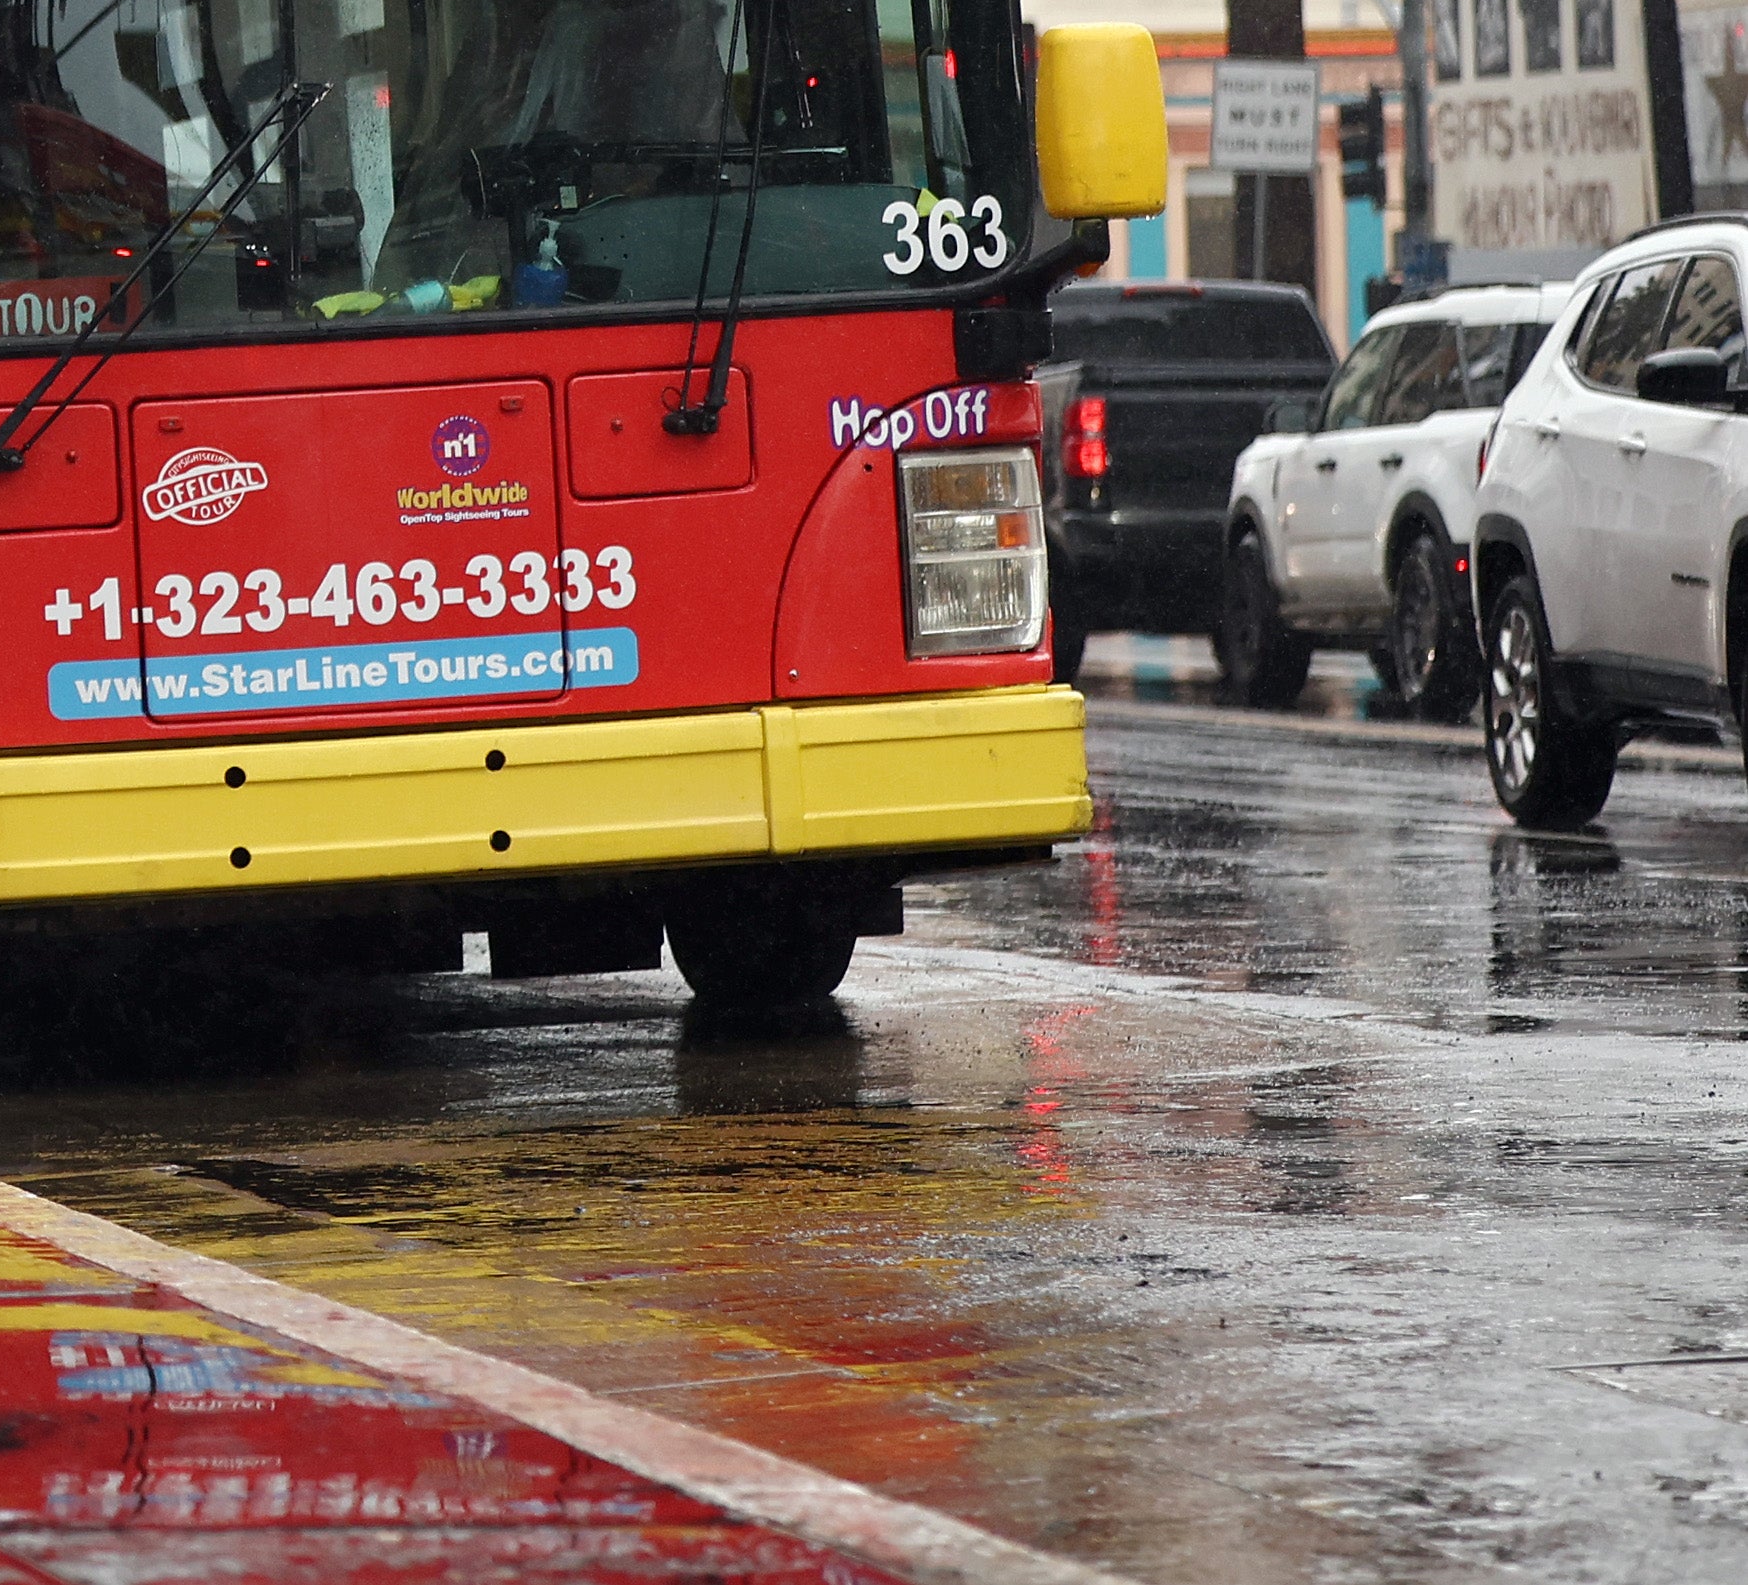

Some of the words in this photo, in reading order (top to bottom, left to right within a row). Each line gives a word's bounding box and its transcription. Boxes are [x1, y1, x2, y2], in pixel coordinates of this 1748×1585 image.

[881, 194, 1009, 275] 363
[830, 396, 915, 451] Hop
[924, 388, 990, 437] Off
[167, 451, 230, 479] CITYSIGHTSEEING
[156, 467, 260, 511] OFFICIAL
[190, 495, 237, 520] TOUR
[396, 480, 528, 510] Worldwide
[444, 509, 501, 523] Sightseeing
[502, 507, 530, 518] Tours
[44, 544, 638, 641] +1-323-463-3333
[74, 641, 615, 705] www.StarLineTours.com
